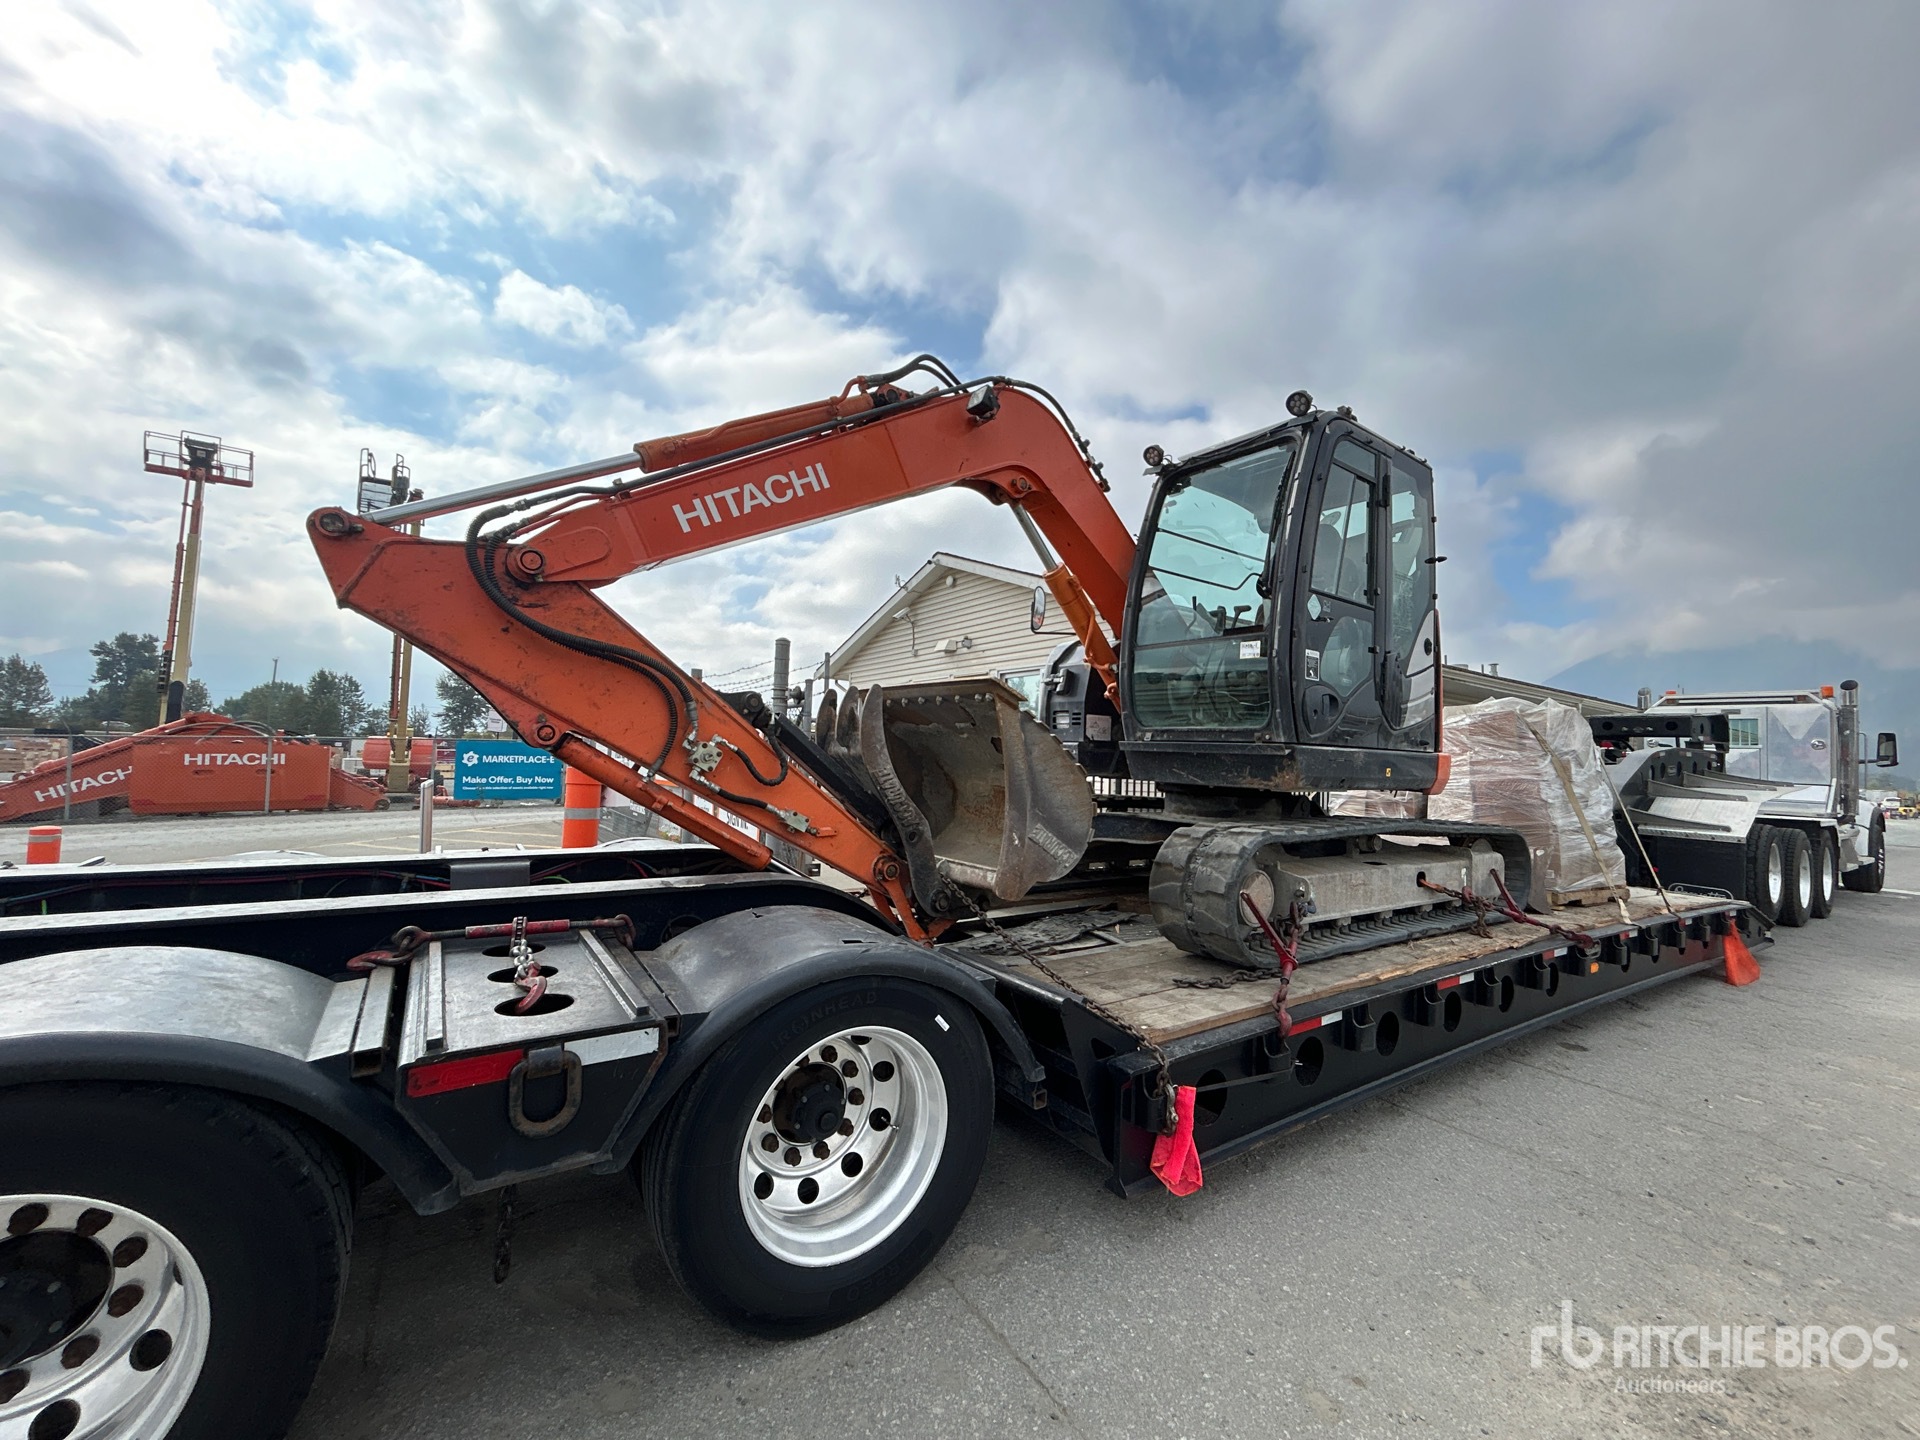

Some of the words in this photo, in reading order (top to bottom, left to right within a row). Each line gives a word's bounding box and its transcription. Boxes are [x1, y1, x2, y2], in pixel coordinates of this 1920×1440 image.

[672, 462, 831, 534] HITACHI
[183, 753, 286, 766] HITACHI
[462, 776, 487, 784] Make
[488, 775, 515, 785] Offer,
[516, 775, 533, 786] Buy
[534, 775, 555, 784] Now
